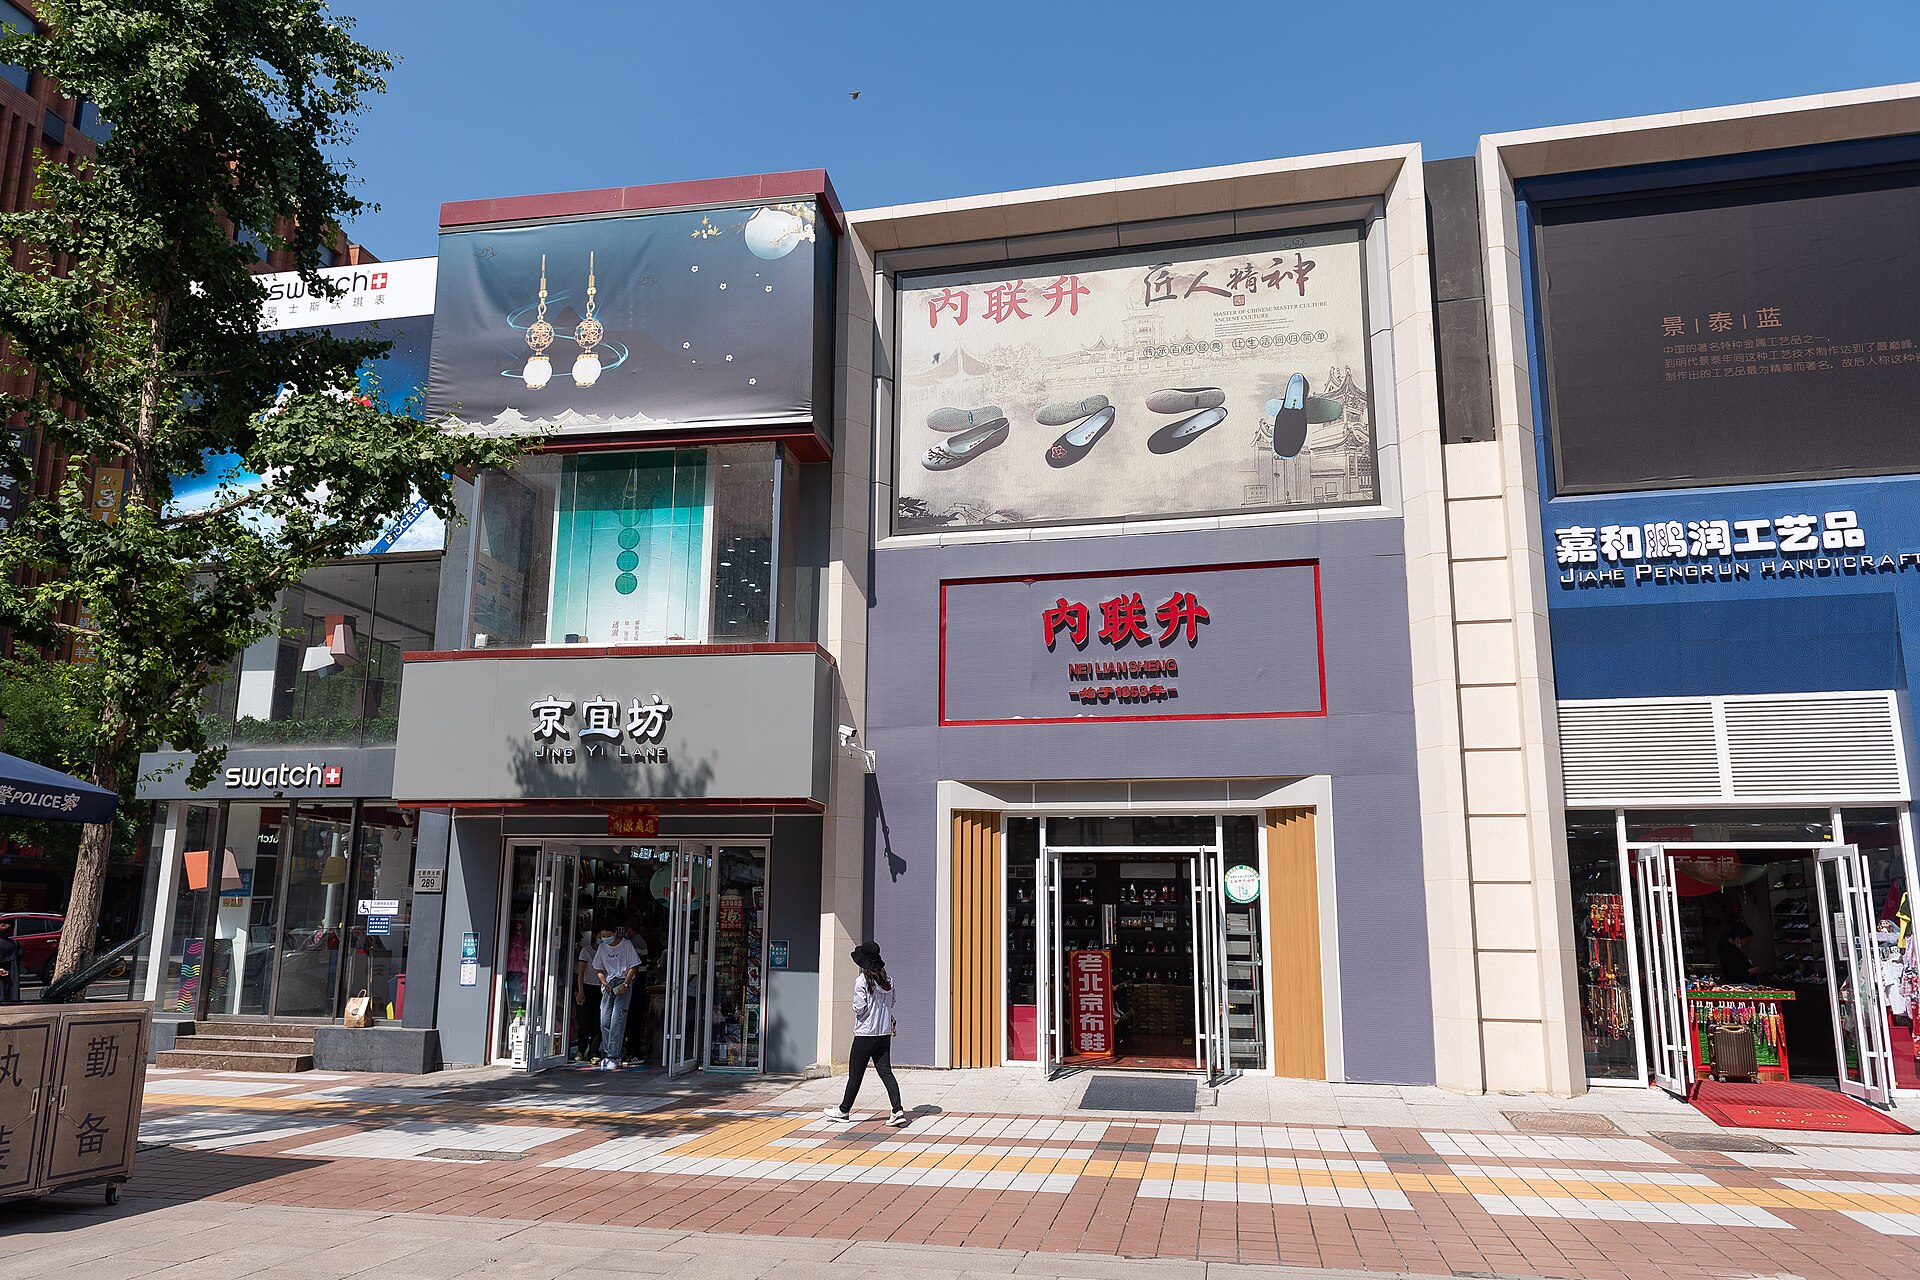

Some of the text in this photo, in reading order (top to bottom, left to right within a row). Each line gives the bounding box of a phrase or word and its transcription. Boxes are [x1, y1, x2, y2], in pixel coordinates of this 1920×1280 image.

[1144, 253, 1316, 307] 匠人精神
[267, 294, 385, 316] 瑞士斯沃琪表
[928, 276, 1090, 328] 内联升
[1143, 330, 1328, 358] 传承百年经典 让生活回归简单
[1555, 511, 1867, 564] 嘉和鹏润工艺品
[1560, 567, 1625, 584] JIAHE
[1635, 563, 1750, 580] PENGRUN
[1042, 592, 1210, 647] 内联升
[1069, 658, 1177, 674] NEI LIAN SHENG
[530, 694, 671, 739] 京宜坊
[534, 745, 666, 757] JING YI LANE
[225, 762, 322, 786] swatch
[421, 878, 435, 888] 289
[1078, 954, 1105, 1051] 老北京布鞋
